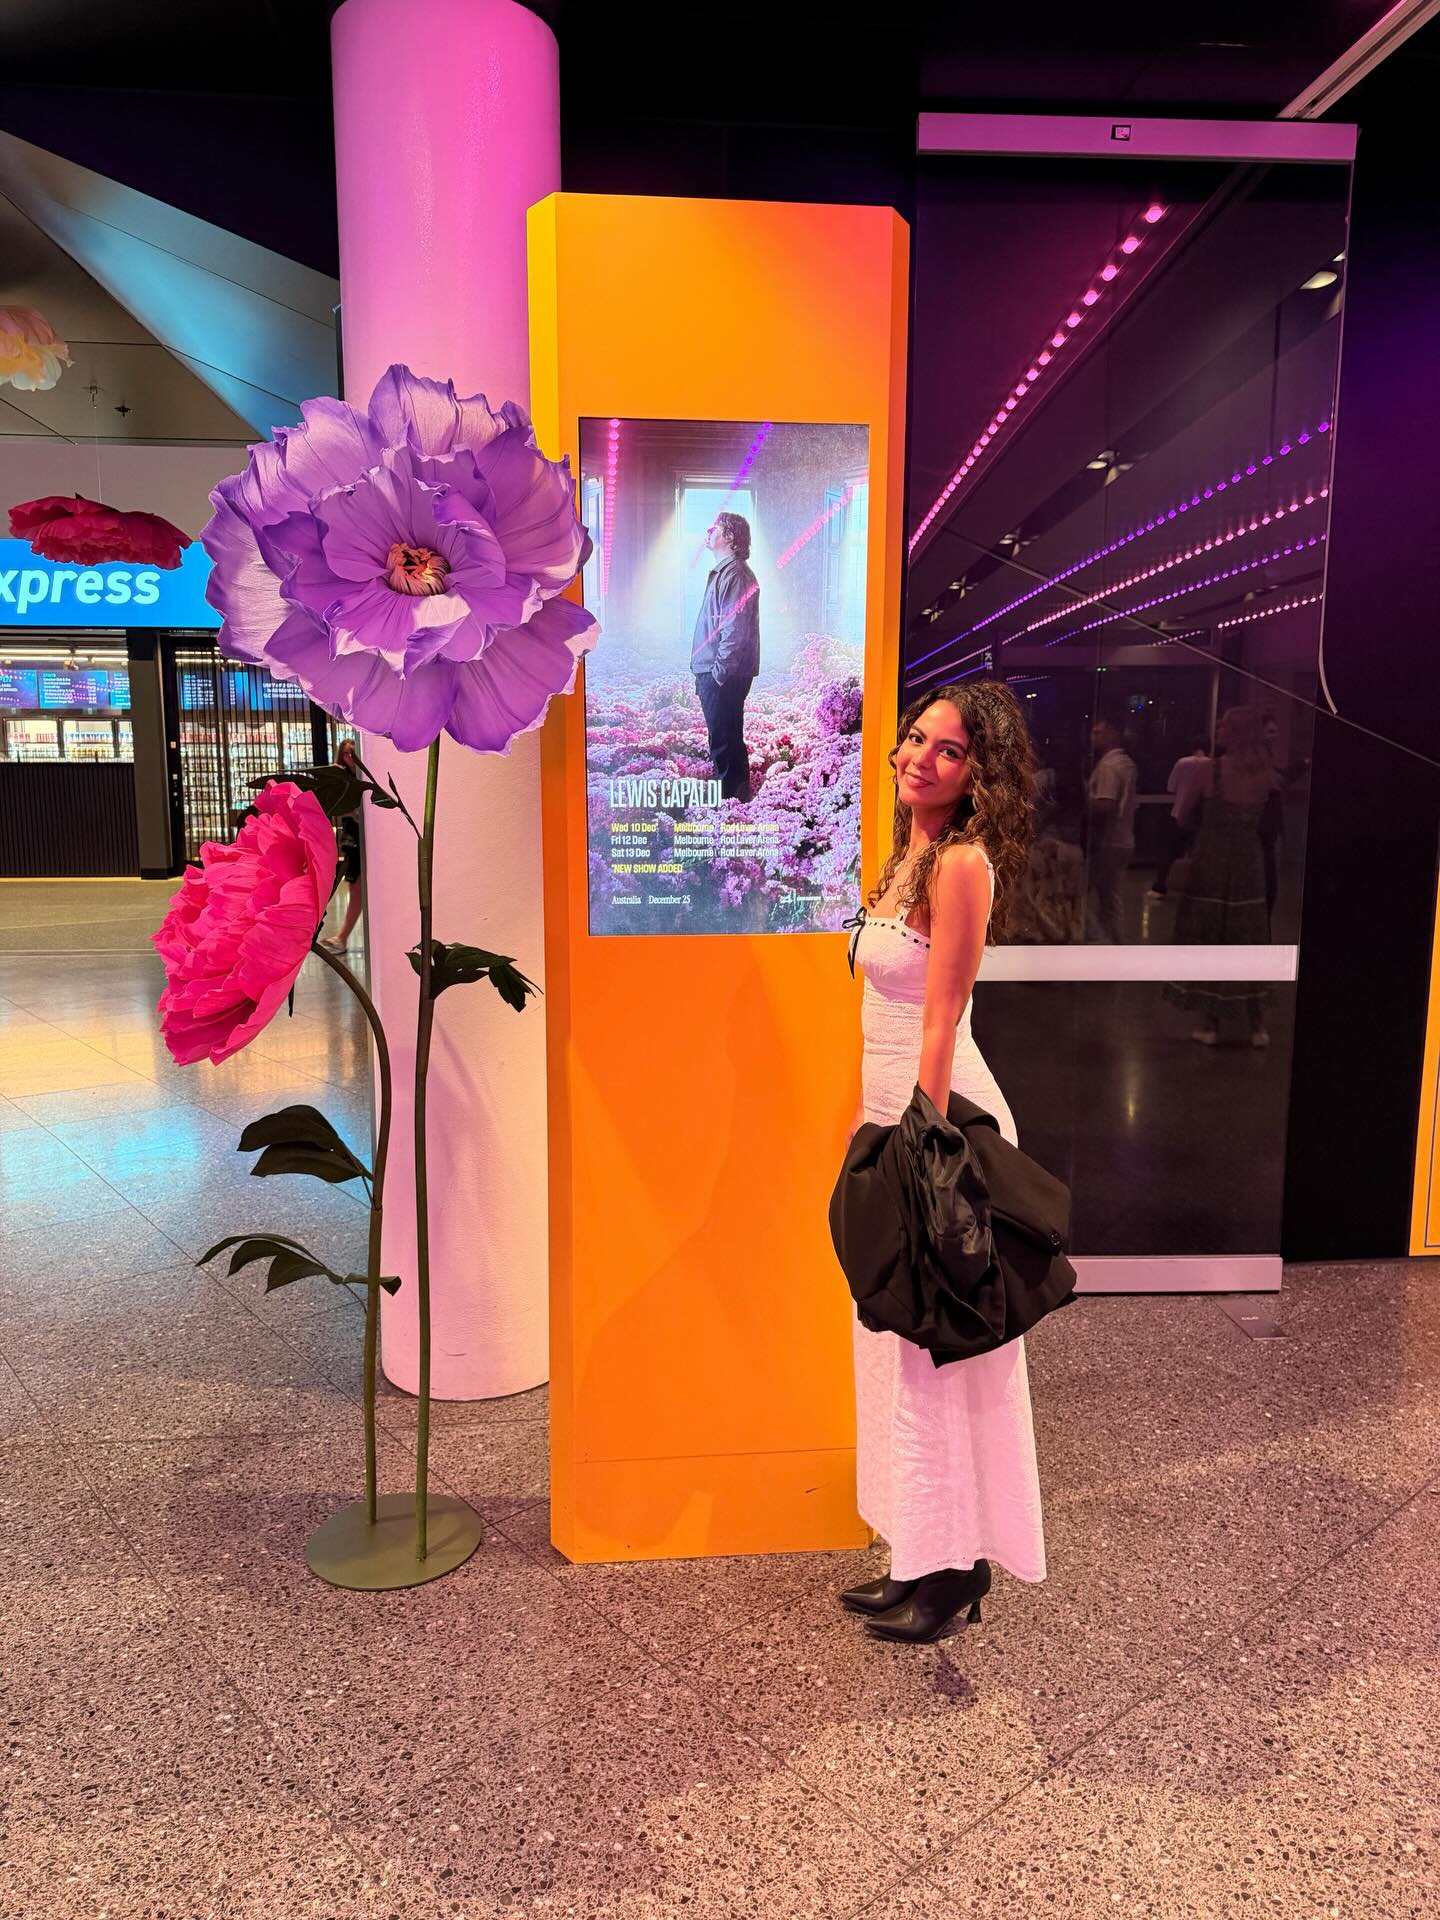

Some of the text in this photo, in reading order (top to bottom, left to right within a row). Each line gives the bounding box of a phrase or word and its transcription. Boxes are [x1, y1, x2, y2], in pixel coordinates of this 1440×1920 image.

[0, 570, 161, 614] xpress
[609, 779, 722, 808] LEWIS CAPALDI
[611, 823, 628, 832] Wed
[631, 823, 641, 832] 10
[674, 823, 714, 832] Melbourne
[720, 823, 735, 832] Rod
[736, 823, 756, 832] Laver
[757, 823, 779, 832] Arena
[611, 836, 779, 845] Fri 12 Dec Melbourne Rod Laver Arena
[611, 848, 779, 857] Sat 13 Dec Melbourne Rod Laver Arena
[633, 864, 656, 873] SHOW
[657, 864, 683, 873] ADDED
[612, 895, 691, 904] Australia December 25
